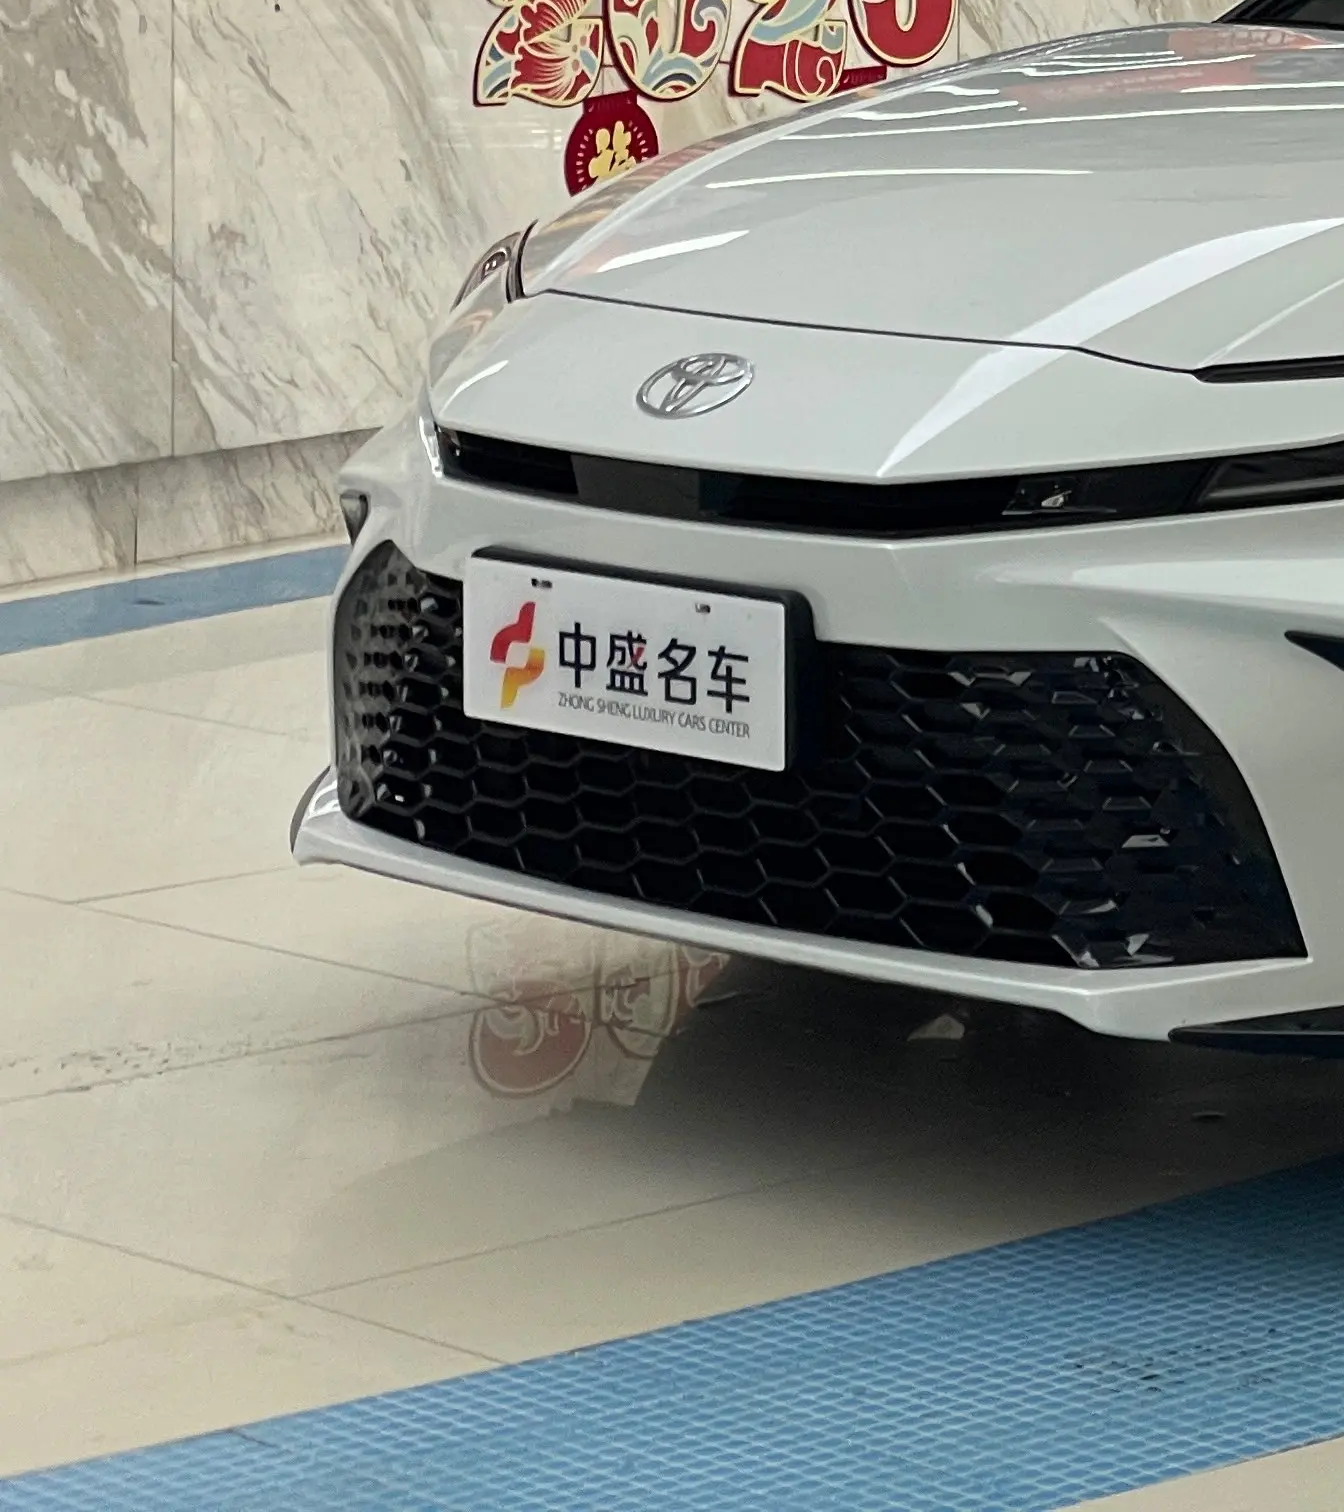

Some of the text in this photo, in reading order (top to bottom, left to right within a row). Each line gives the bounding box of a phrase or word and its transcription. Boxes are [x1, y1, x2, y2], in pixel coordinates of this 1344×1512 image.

[557, 620, 751, 715] 中盛名车
[558, 691, 751, 739] ZHONG SHENG LUXURY CARS CENTER
